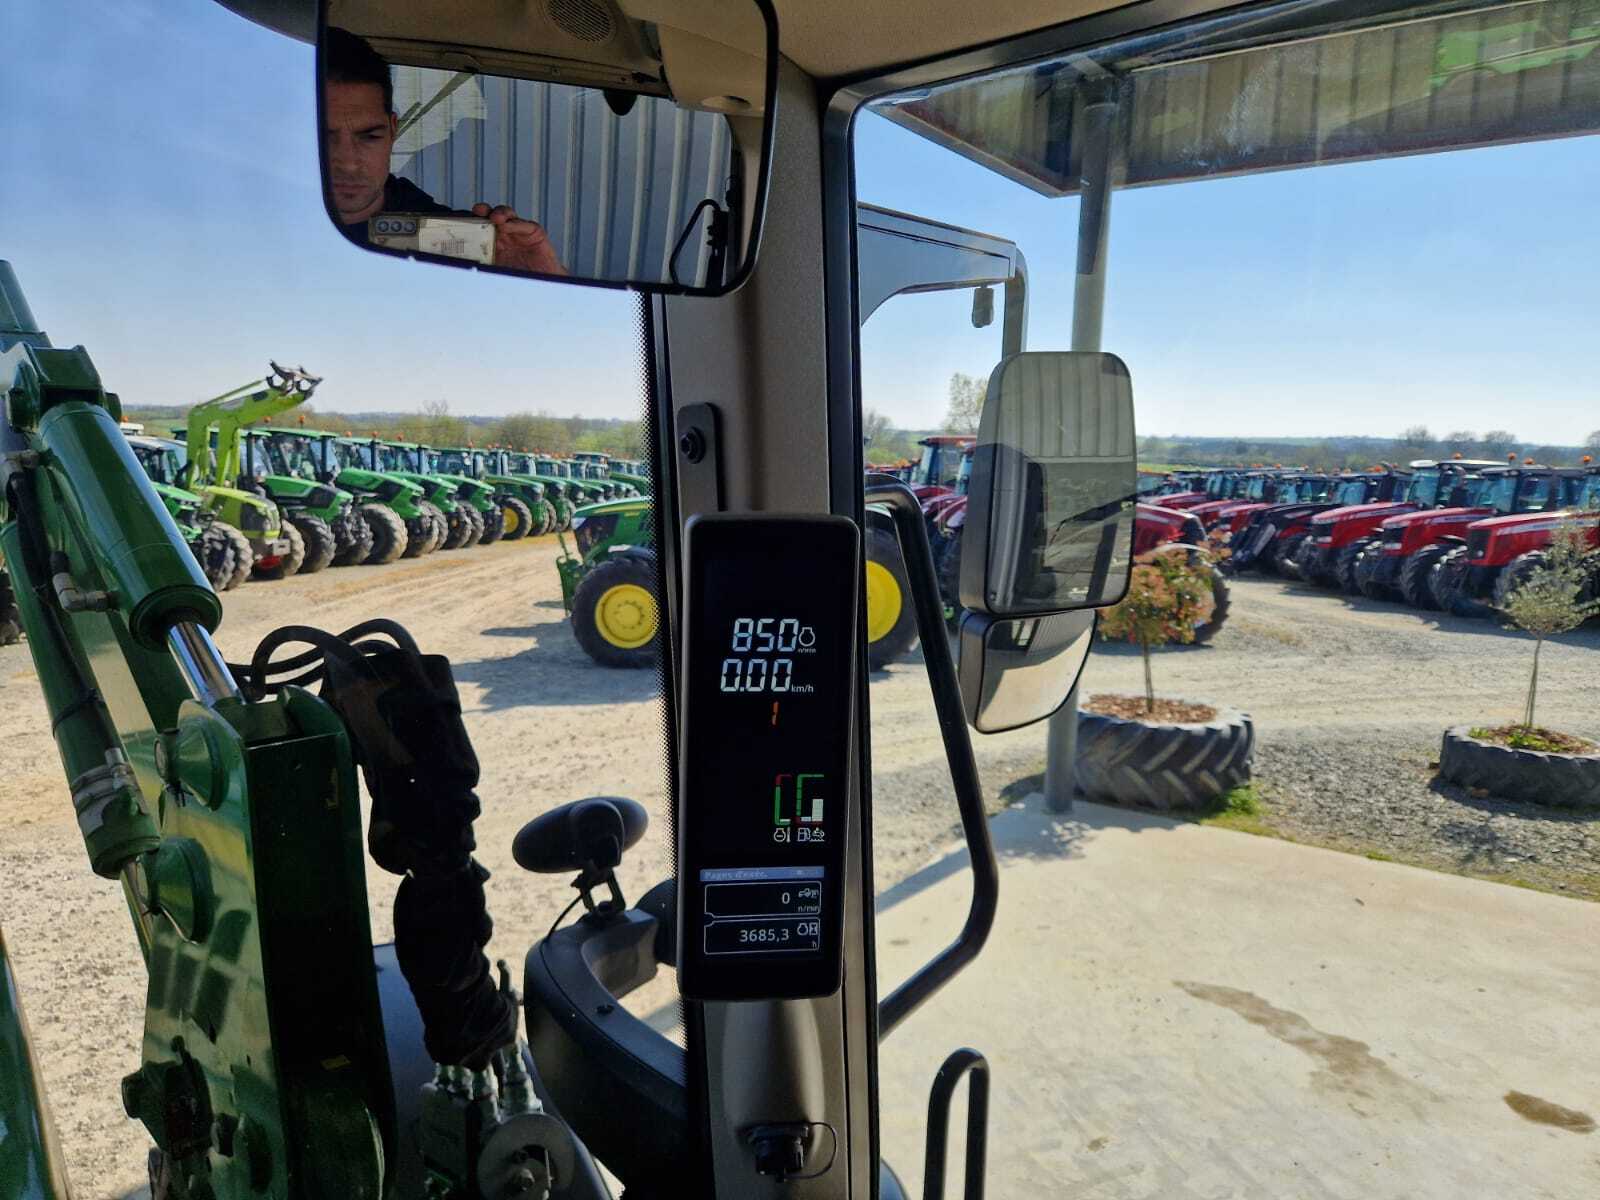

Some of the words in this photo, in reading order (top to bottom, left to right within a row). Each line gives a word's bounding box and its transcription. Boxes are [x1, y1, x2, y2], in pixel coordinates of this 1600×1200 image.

[732, 617, 799, 652] 850
[720, 658, 793, 692] 0.00
[791, 683, 814, 692] km/h
[781, 892, 790, 904] 0
[739, 928, 789, 943] 3685,3
